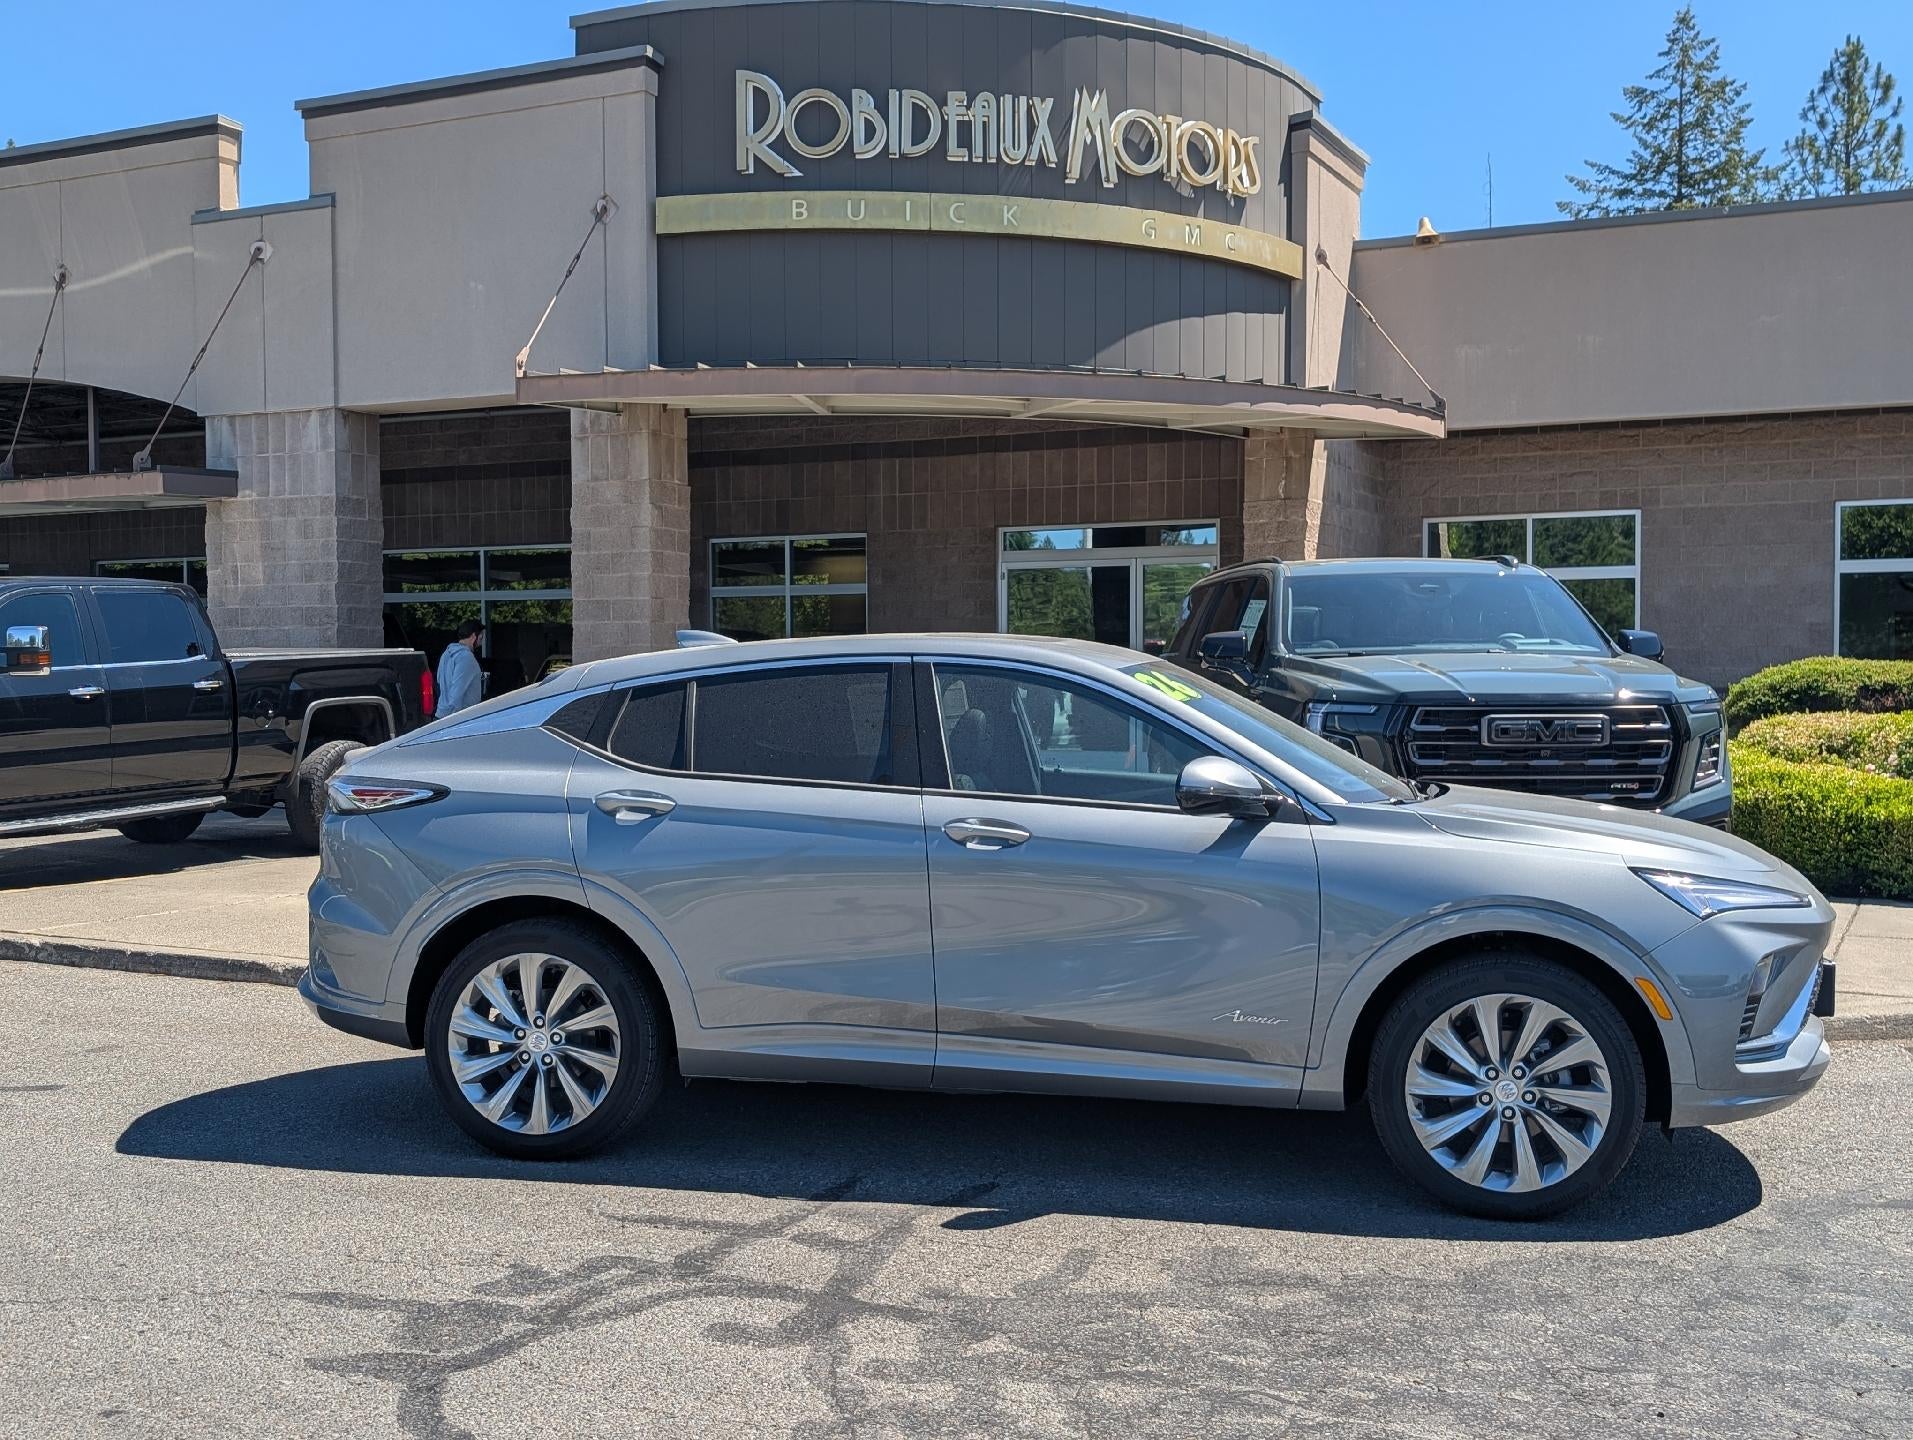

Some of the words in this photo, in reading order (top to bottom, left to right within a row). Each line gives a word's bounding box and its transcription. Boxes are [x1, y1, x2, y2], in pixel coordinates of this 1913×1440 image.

[736, 70, 1058, 177] ROBIDEAUX
[1064, 84, 1262, 198] MOTORS
[791, 199, 1018, 227] BUICK
[1141, 217, 1236, 253] GMC
[1491, 719, 1602, 742] GMC
[1211, 1009, 1289, 1025] Avenir
